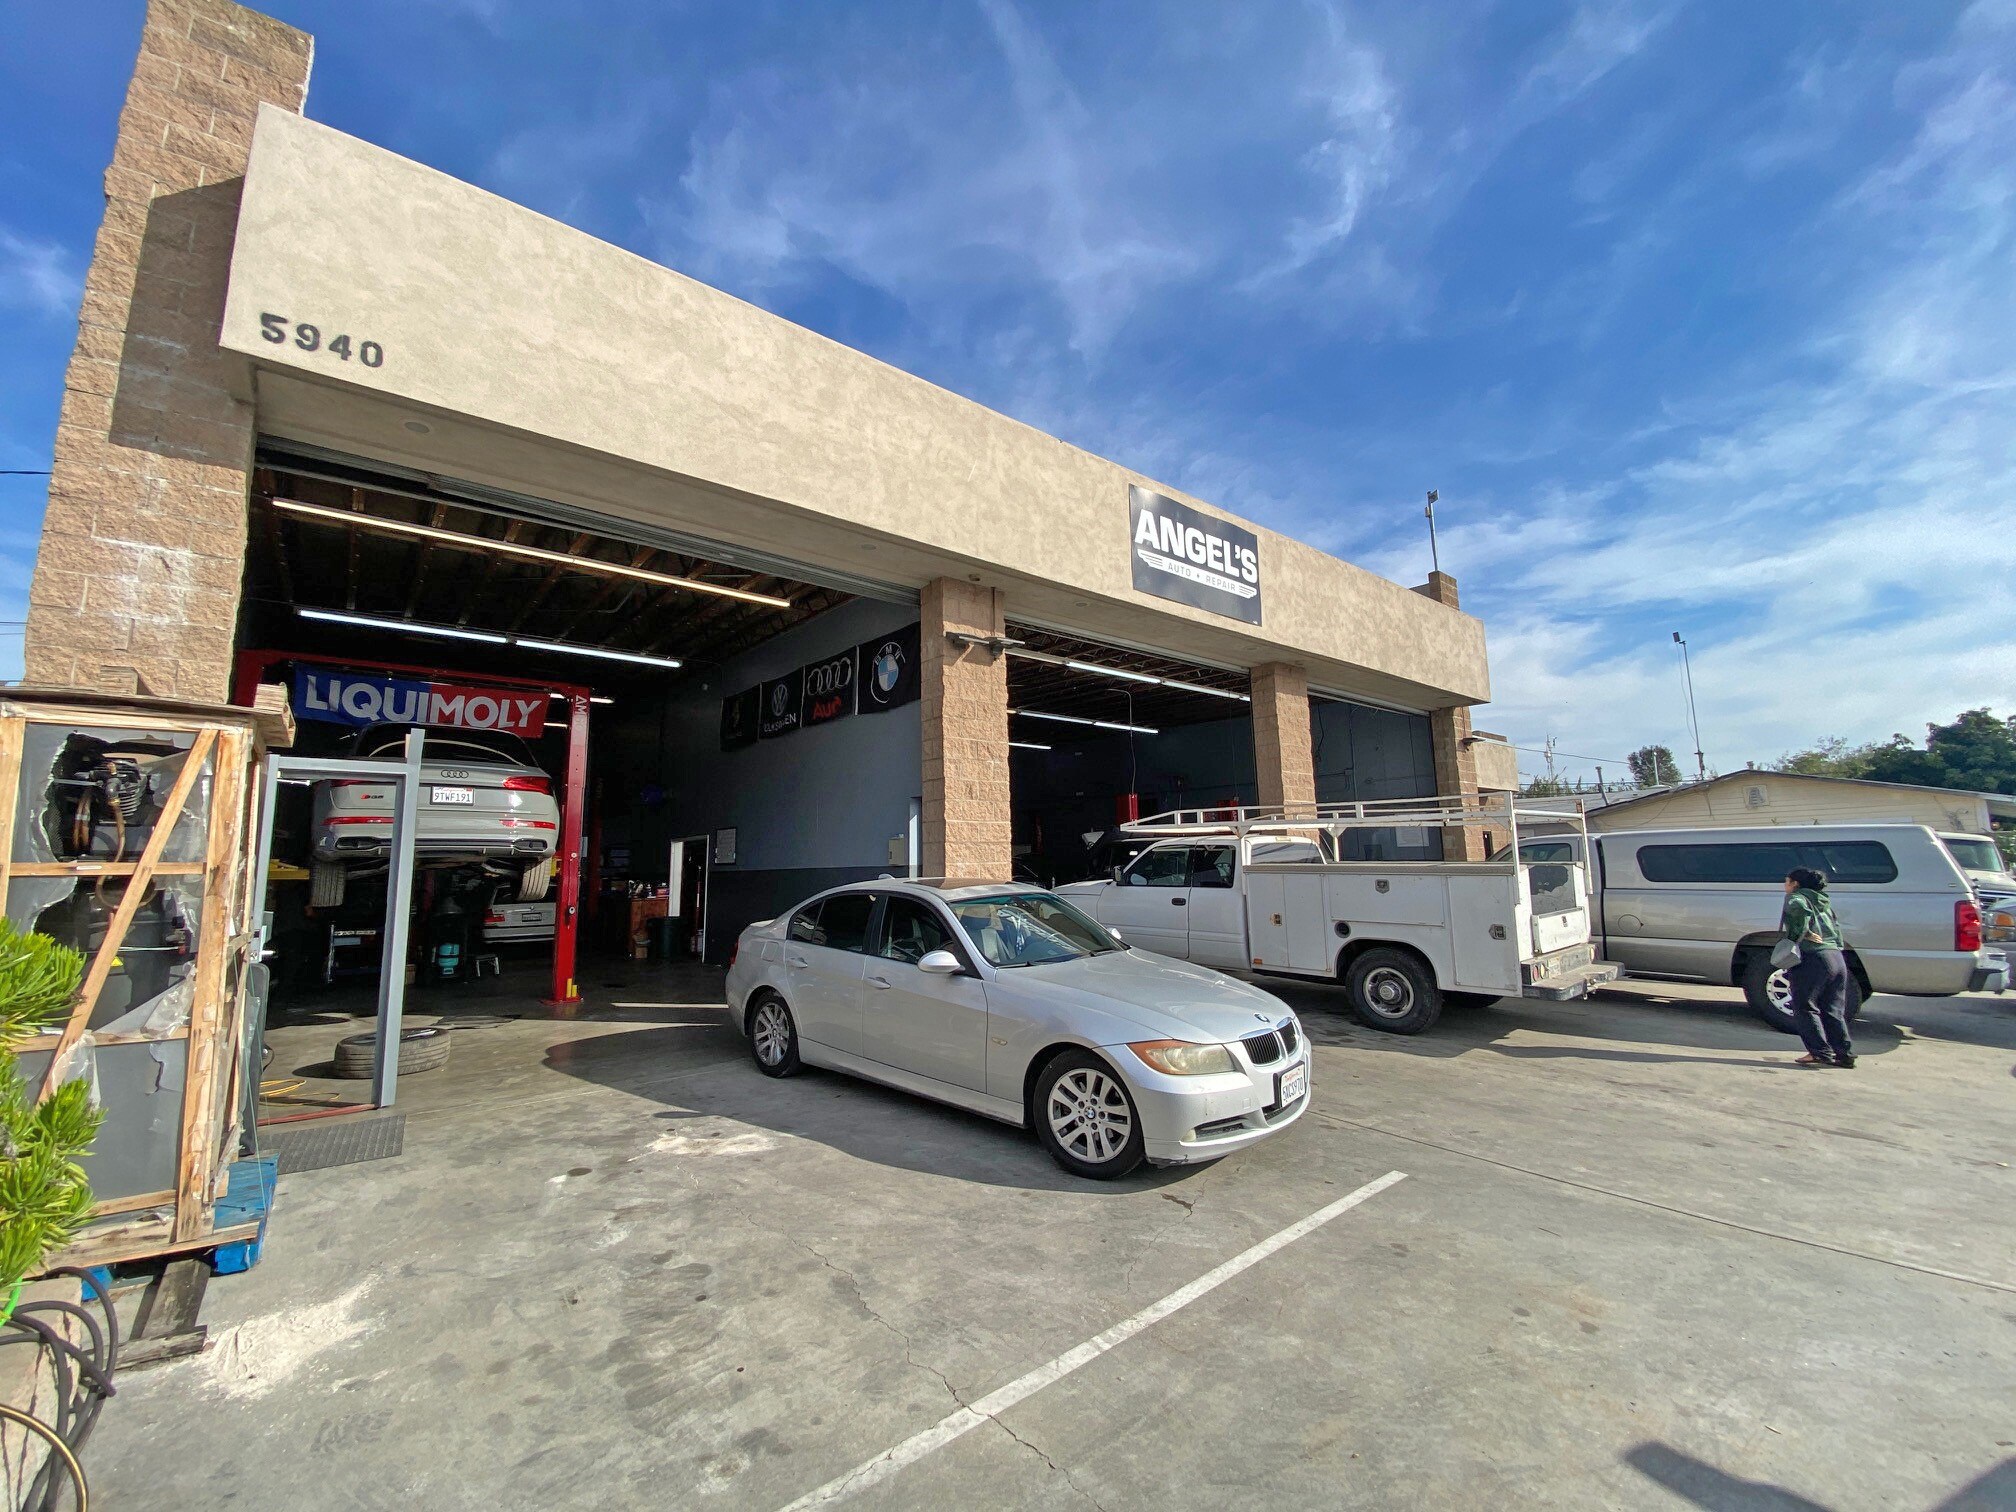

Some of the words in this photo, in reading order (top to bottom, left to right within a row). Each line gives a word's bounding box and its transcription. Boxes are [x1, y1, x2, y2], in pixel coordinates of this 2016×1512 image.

[260, 312, 383, 368] 5940
[1135, 508, 1258, 584] ANGEL'S
[1168, 562, 1191, 577] AUTO
[1205, 575, 1236, 592] REPAIR
[434, 792, 471, 803] 9TWF191
